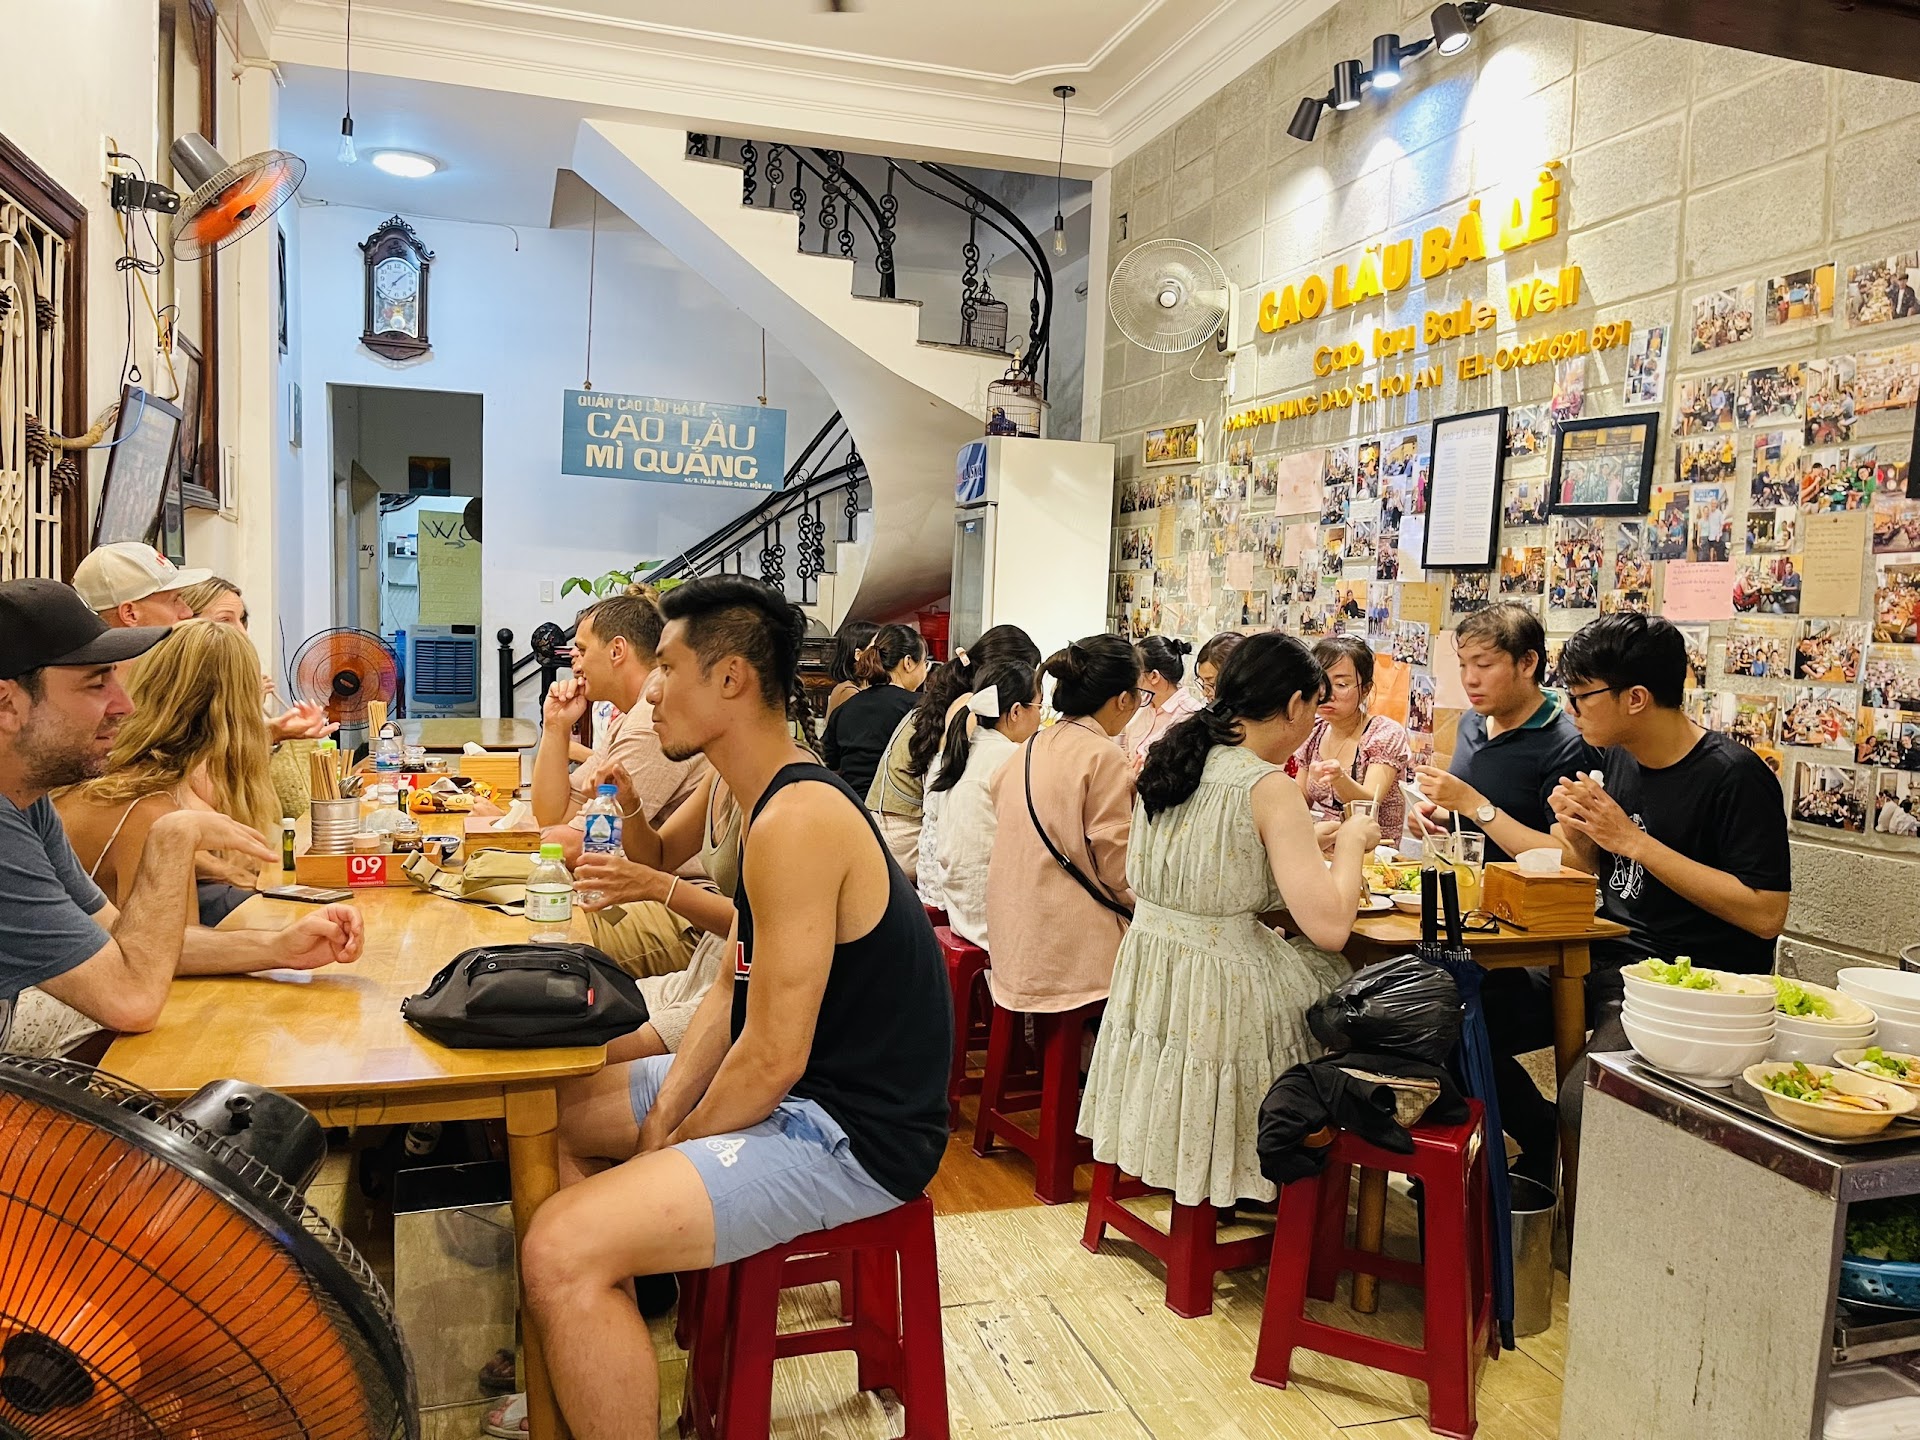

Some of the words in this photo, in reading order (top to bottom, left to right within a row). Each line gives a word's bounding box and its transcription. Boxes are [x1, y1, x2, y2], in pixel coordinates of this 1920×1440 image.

[1258, 274, 1327, 334] CAO
[1420, 199, 1487, 279] BÁ
[1313, 341, 1364, 377] Cao
[1507, 265, 1581, 320] Well
[577, 394, 613, 408] QUÁN
[617, 398, 642, 411] CAO
[1320, 387, 1353, 412] DAO
[1380, 373, 1411, 398] HOI
[1414, 364, 1443, 390] AN
[1457, 353, 1493, 381] TEL:
[586, 412, 664, 443] CAO
[680, 411, 756, 450] LẦU
[585, 440, 624, 469] MÌ
[633, 439, 759, 480] QUẢNG
[351, 856, 382, 874] 09
